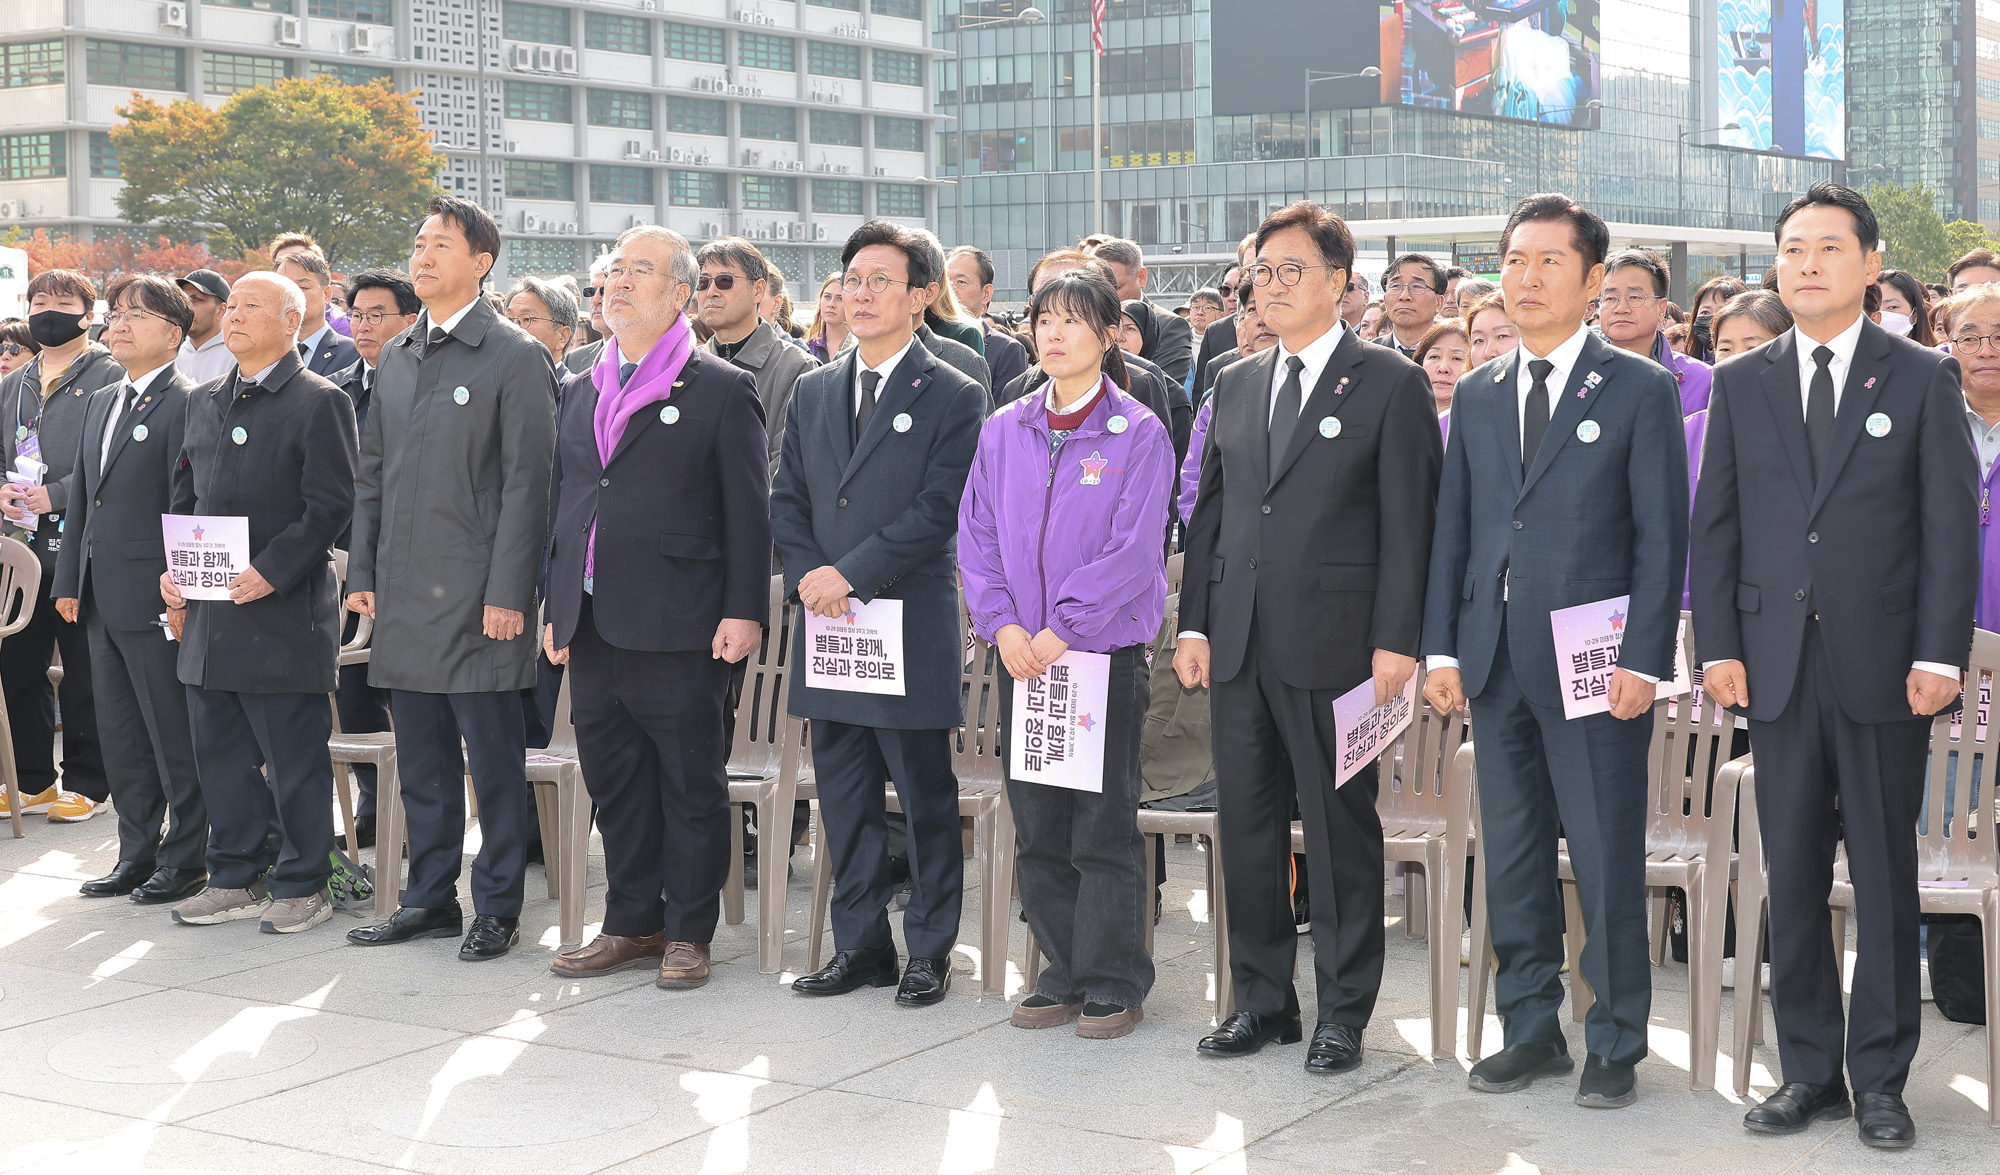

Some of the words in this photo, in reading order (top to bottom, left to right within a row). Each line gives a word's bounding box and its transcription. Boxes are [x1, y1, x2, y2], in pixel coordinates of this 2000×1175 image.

[171, 549, 200, 567] 별들과
[203, 551, 234, 570] 함께,
[171, 568, 198, 587] 진실과
[815, 634, 853, 655] 별들과
[856, 637, 888, 660] 함께,
[812, 656, 851, 677] 진실과
[854, 660, 896, 680] 정의로
[1571, 672, 1613, 701] 진실
[1026, 673, 1046, 713] 실과
[1048, 665, 1069, 720] 별들과
[1025, 718, 1044, 771] 정의로
[1043, 724, 1066, 765] 함께,
[1343, 731, 1377, 771] 진실과
[1380, 700, 1409, 740] 정의로
[1347, 709, 1381, 749] 별들과
